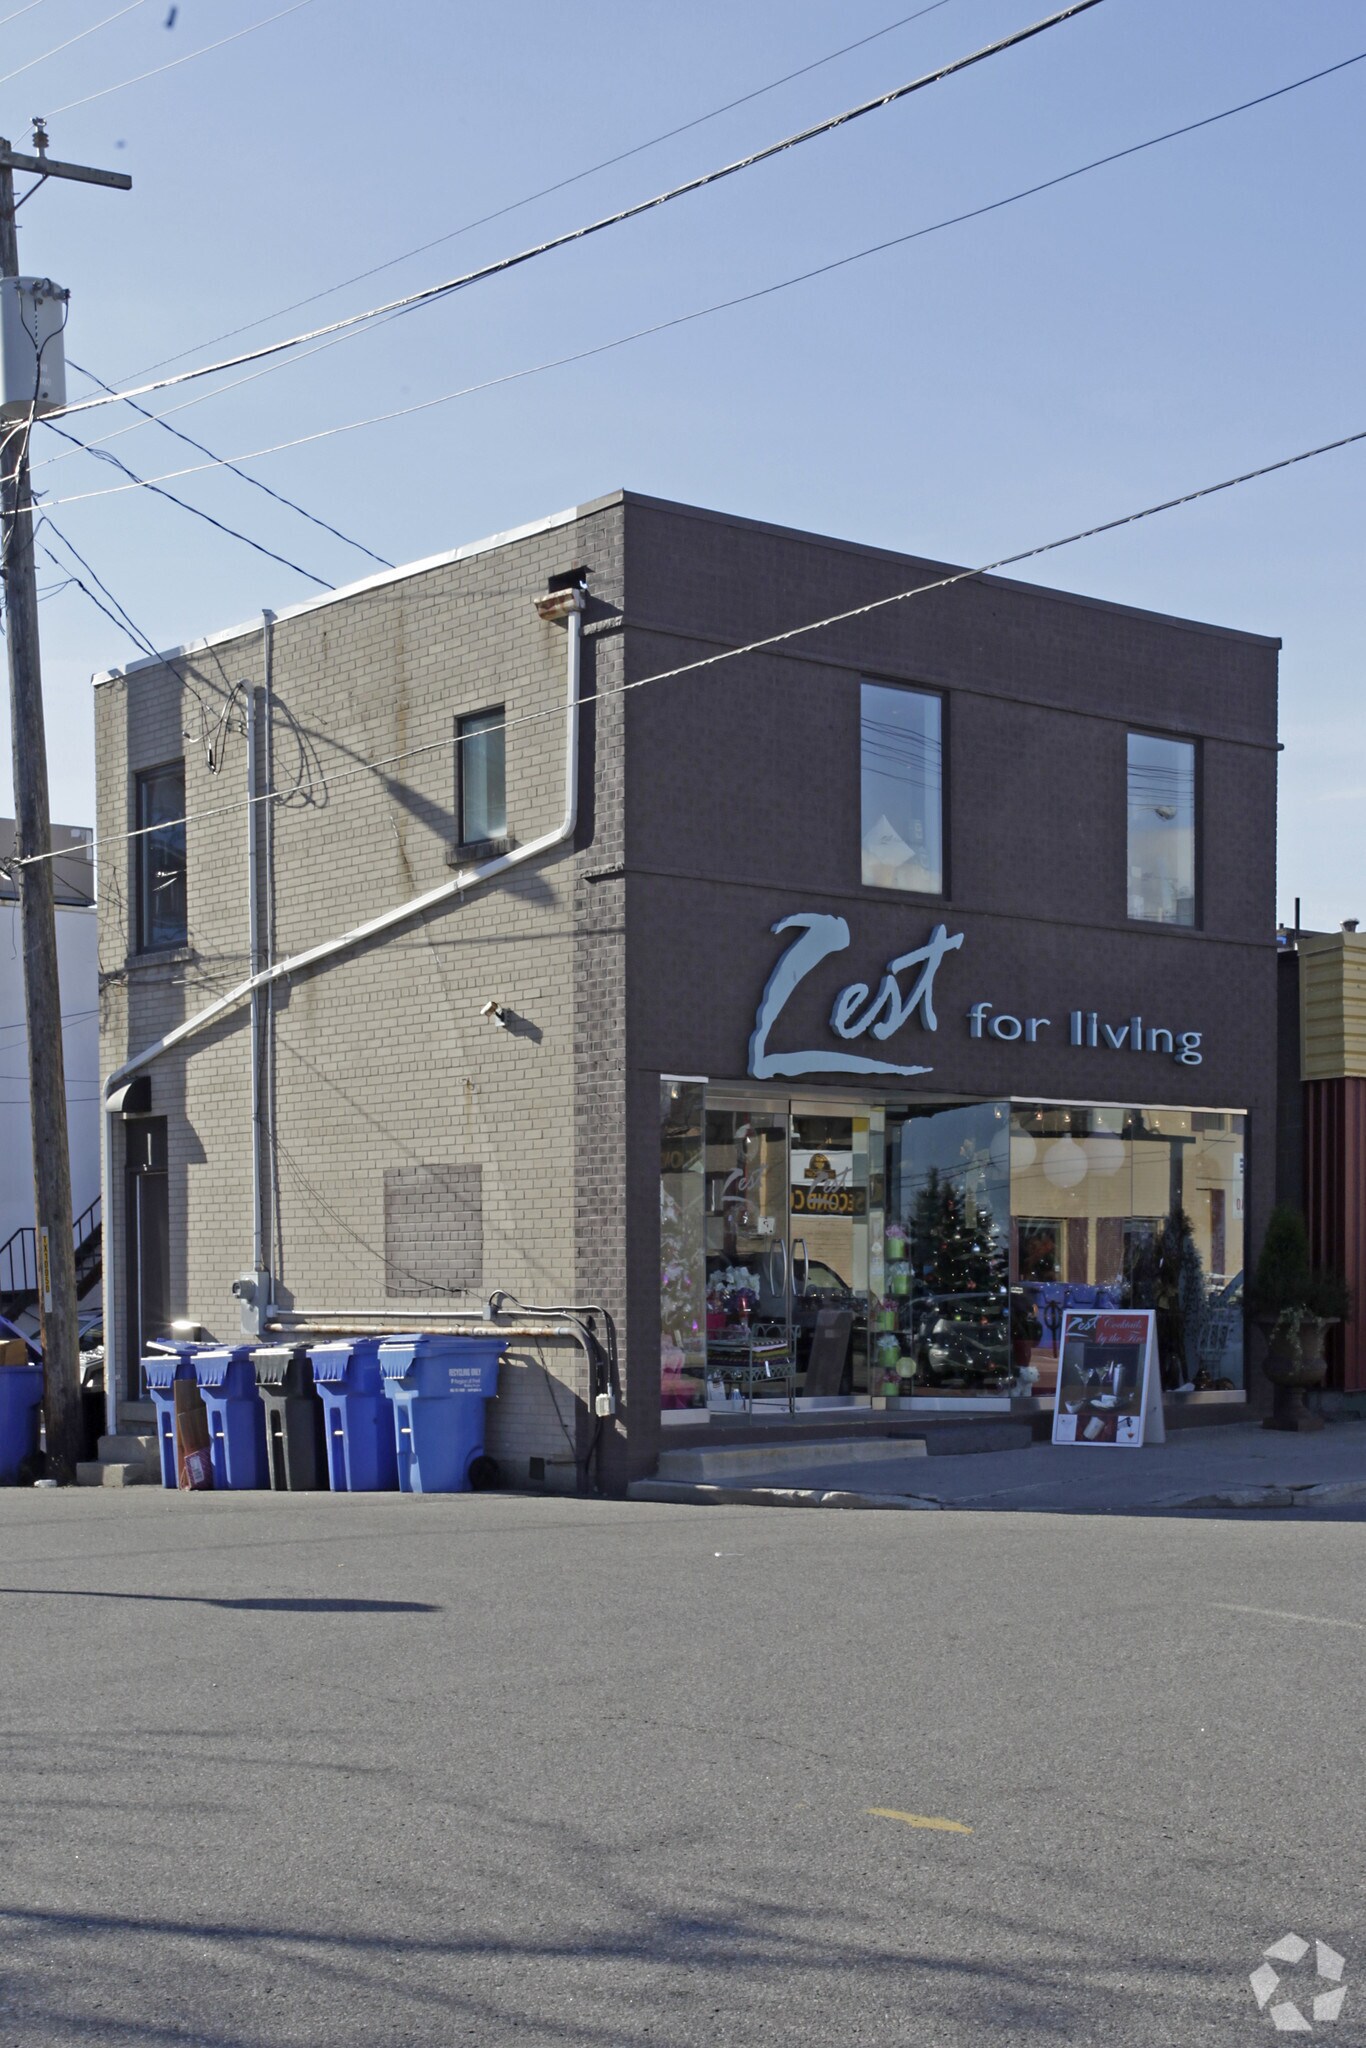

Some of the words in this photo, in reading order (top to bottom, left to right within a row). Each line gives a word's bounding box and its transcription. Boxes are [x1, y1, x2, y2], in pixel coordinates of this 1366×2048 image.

[748, 913, 964, 1079] Zest
[966, 1002, 1050, 1041] for
[1070, 1011, 1202, 1065] living
[721, 1163, 768, 1203] Zest
[807, 1166, 852, 1205] Zest
[1066, 1315, 1101, 1337] Zest
